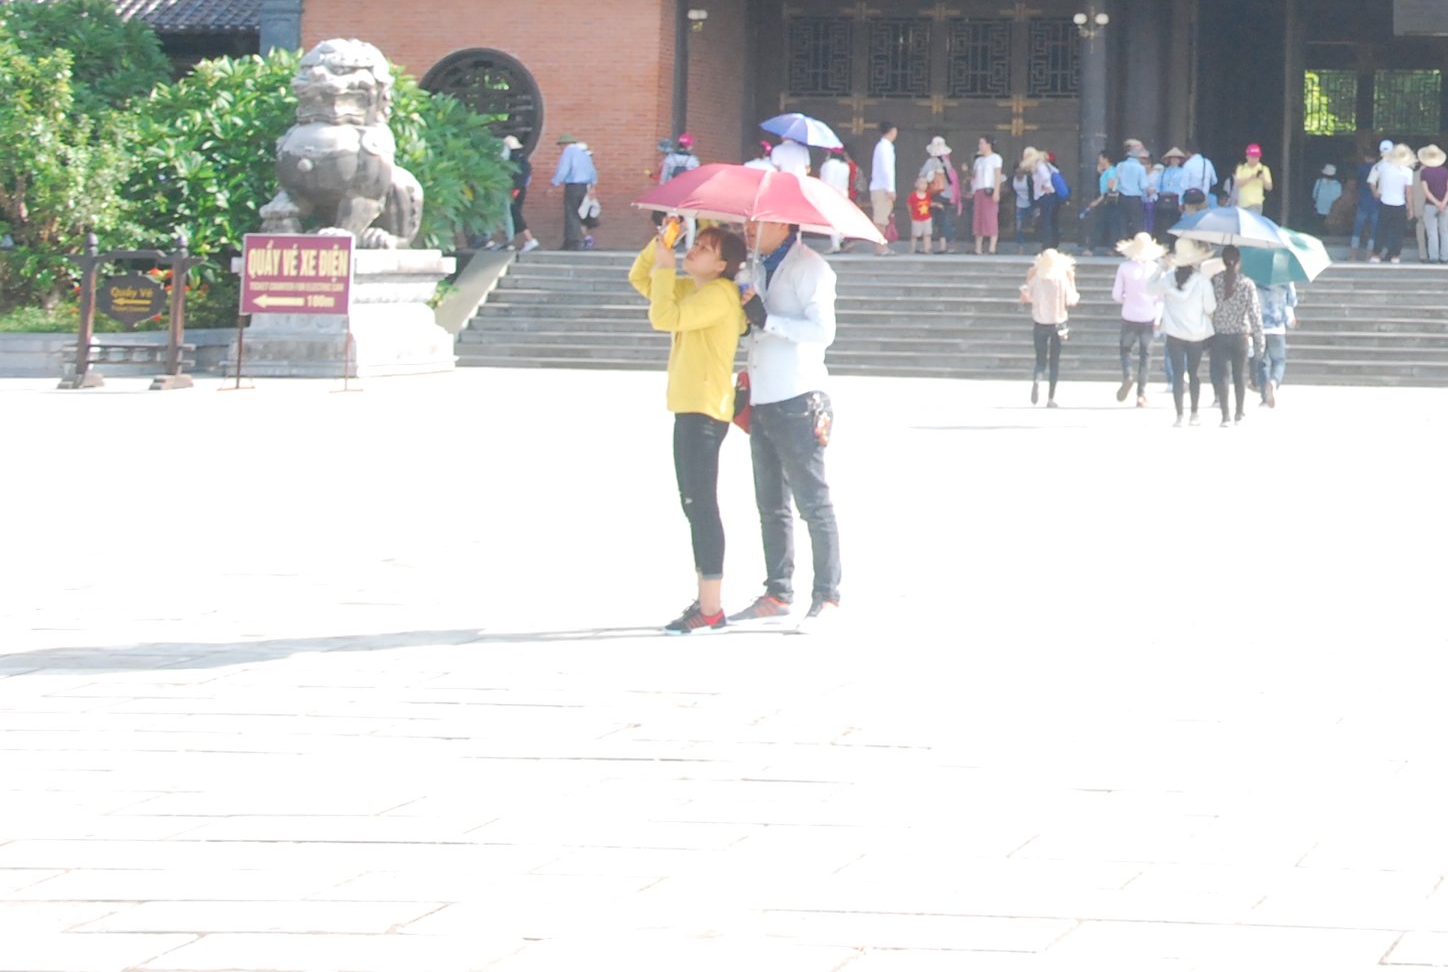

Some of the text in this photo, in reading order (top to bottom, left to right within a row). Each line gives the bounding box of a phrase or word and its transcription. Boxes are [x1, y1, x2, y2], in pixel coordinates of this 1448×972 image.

[282, 244, 298, 276] VÉ
[300, 249, 318, 276] XE
[307, 295, 335, 307] 100m
